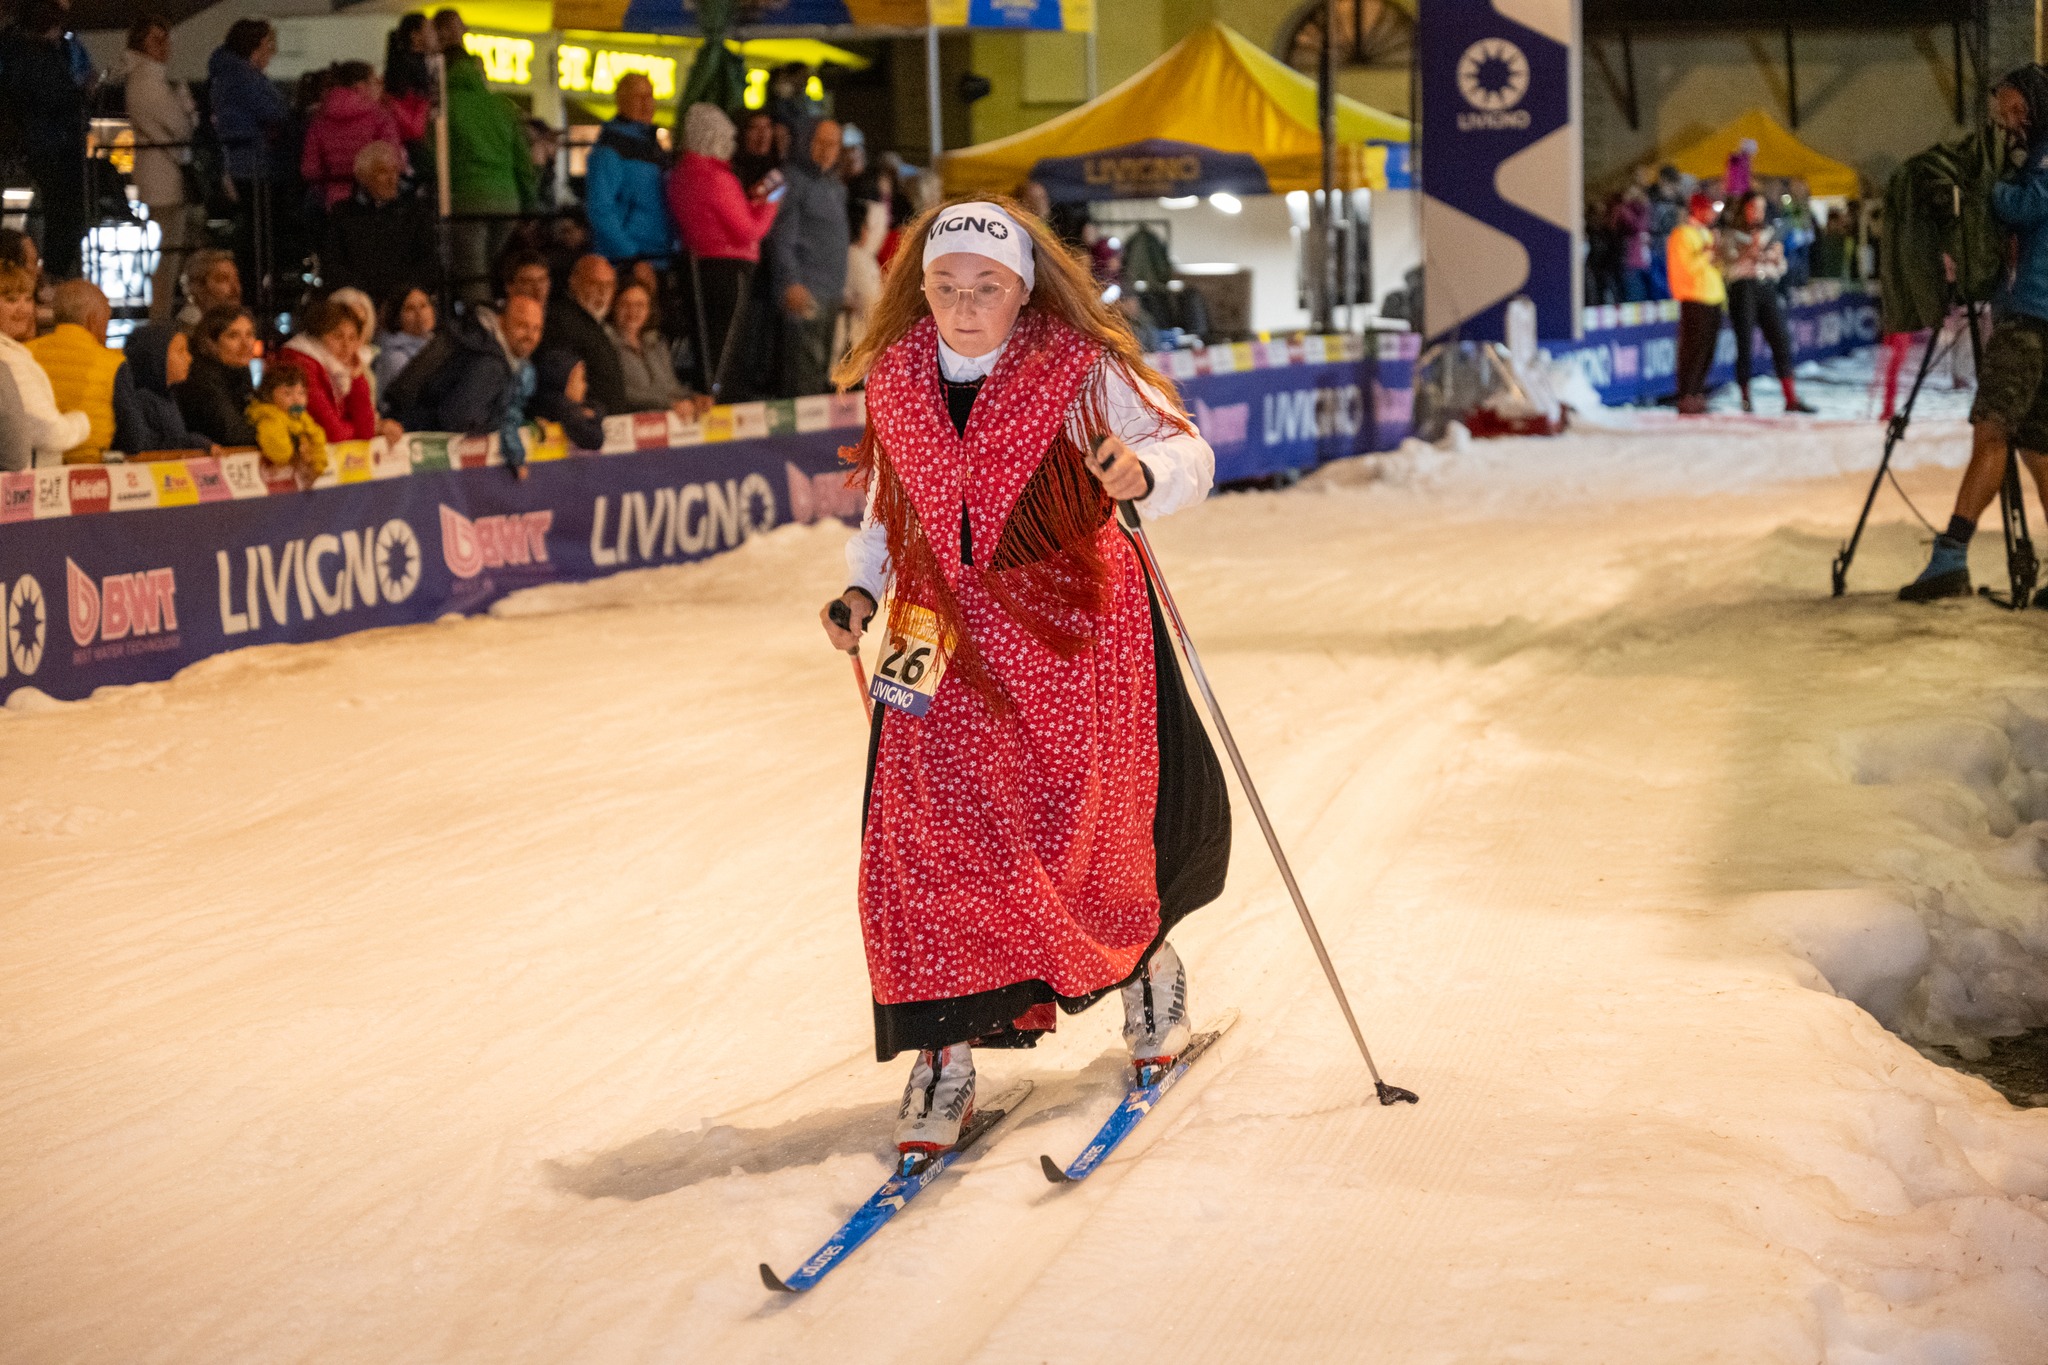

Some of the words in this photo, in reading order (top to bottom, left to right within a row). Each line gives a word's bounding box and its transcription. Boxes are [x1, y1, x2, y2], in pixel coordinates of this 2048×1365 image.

[1457, 109, 1531, 132] LIVIGNO
[1084, 154, 1199, 185] LIVIGNO
[1263, 384, 1364, 446] LIVIGNO
[474, 509, 554, 569] BWT
[590, 473, 776, 566] LIVIGNO
[216, 518, 421, 635] LIVIGNO
[101, 567, 178, 641] BWT
[880, 636, 931, 685] 26
[872, 680, 914, 708] LIVIGNO
[919, 1157, 945, 1189] salomon
